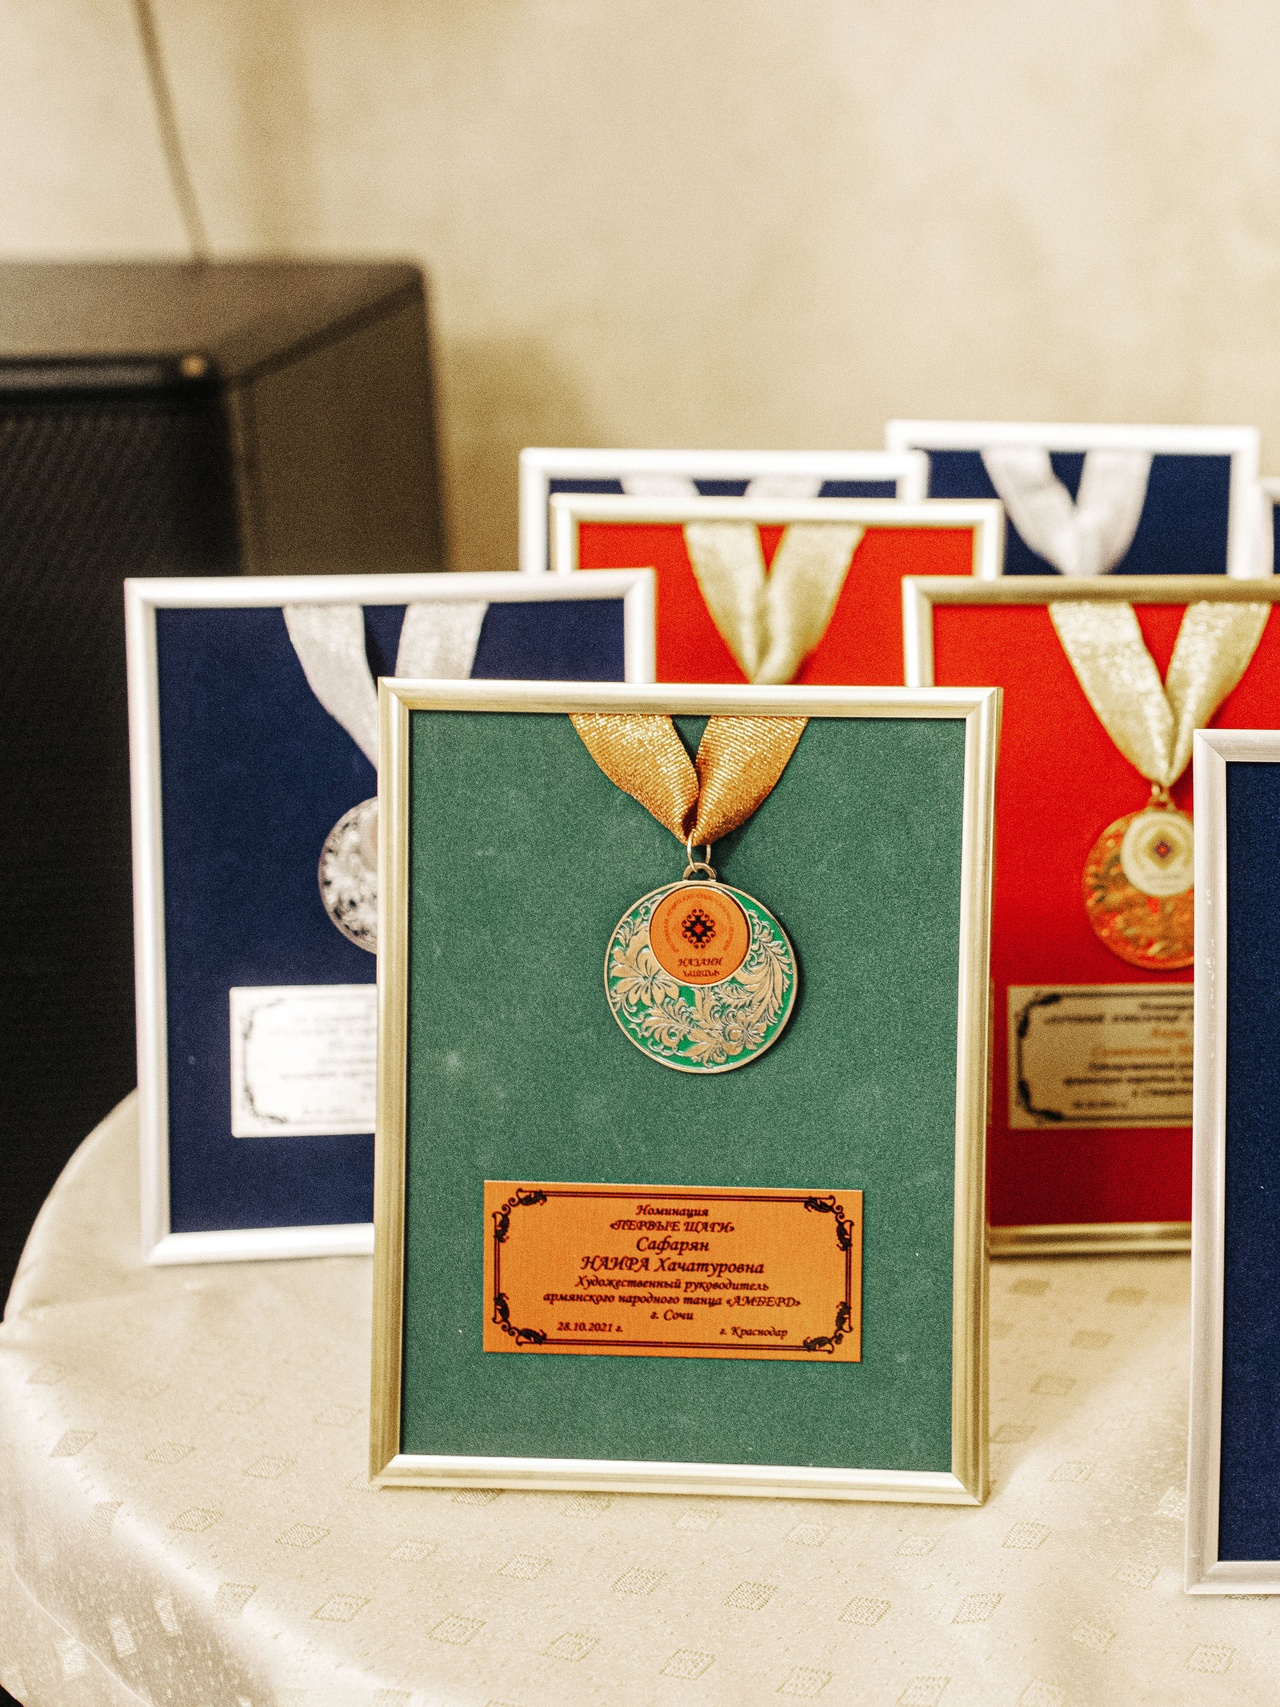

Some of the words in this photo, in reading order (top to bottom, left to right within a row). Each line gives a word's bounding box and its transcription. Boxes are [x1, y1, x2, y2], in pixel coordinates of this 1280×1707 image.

[635, 1204, 709, 1218] Номинация
[610, 1220, 681, 1233] «ПЕРВЫЕ
[683, 1220, 735, 1234] ШАГИ»
[636, 1235, 710, 1255] Сафарян
[580, 1255, 650, 1273] НАИРА
[654, 1258, 764, 1277] Хачатуровна
[575, 1275, 681, 1292] Художественный
[684, 1278, 769, 1293] руководитель
[543, 1293, 615, 1306] армянского
[618, 1292, 680, 1306] народного
[682, 1296, 722, 1307] танца
[725, 1295, 801, 1308] «АМБЕРД»
[650, 1311, 659, 1321] г.
[663, 1308, 694, 1321] Сочи
[557, 1321, 614, 1333] 28.10.2021
[730, 1325, 788, 1340] Краснодар
